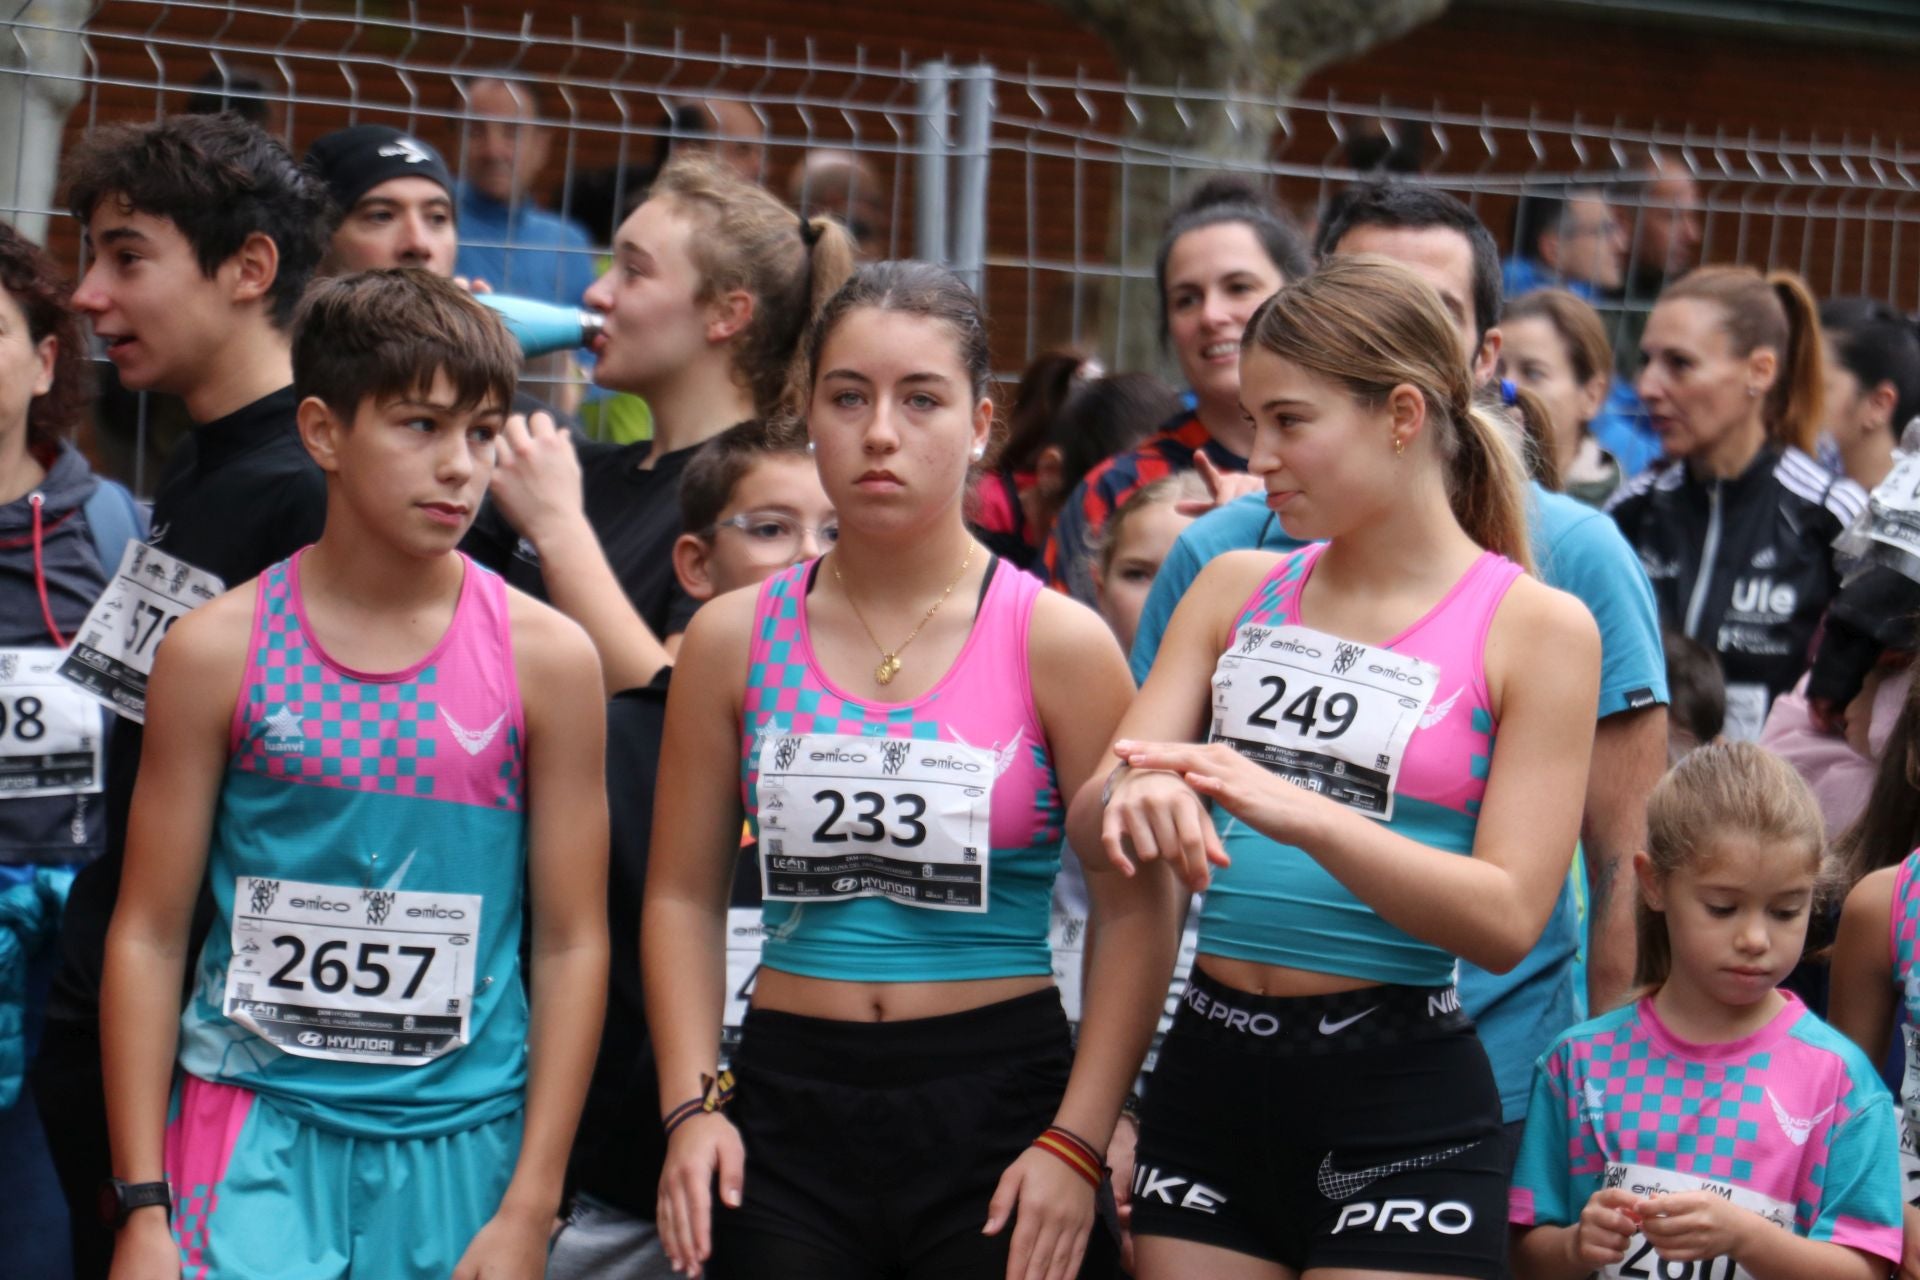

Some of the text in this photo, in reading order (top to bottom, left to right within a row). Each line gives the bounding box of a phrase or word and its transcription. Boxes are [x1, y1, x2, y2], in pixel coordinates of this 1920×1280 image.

[1731, 578, 1798, 615] Ule
[1270, 638, 1322, 659] emico
[1367, 664, 1423, 686] emico
[0, 696, 45, 741] 8
[1246, 675, 1358, 741] 249
[809, 748, 868, 763] emico
[921, 755, 981, 773] emico
[811, 789, 927, 848] 233
[860, 876, 916, 897] HYUNDAI
[289, 895, 351, 912] emico
[406, 903, 466, 920] emico
[267, 935, 437, 1000] 2657
[1181, 980, 1210, 1015] IKE
[1208, 1000, 1279, 1036] PRO
[1427, 987, 1461, 1018] NIK
[327, 1034, 395, 1051] HYUNDAI
[1331, 1199, 1473, 1235] PRO
